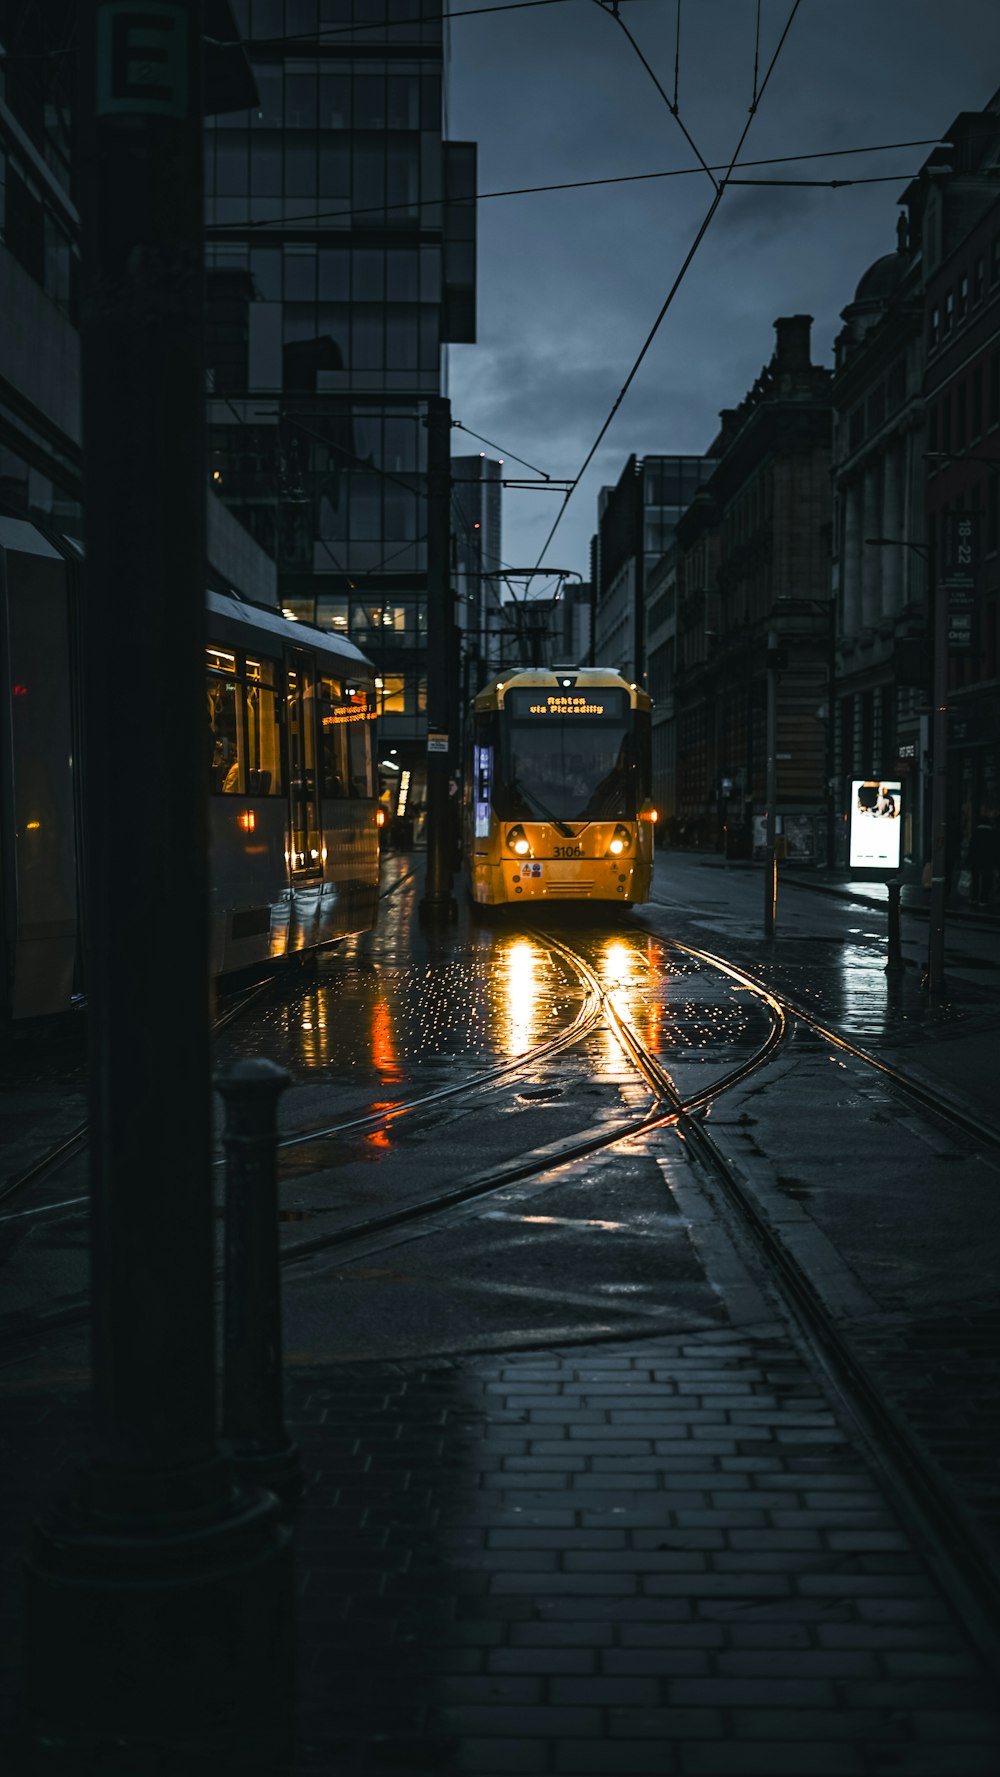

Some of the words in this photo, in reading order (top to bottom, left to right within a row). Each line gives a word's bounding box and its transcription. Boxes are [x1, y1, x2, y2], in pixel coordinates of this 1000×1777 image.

[113, 13, 175, 101] E
[547, 697, 585, 705] Ashton
[530, 705, 547, 713] via
[550, 705, 603, 714] Piccadilly
